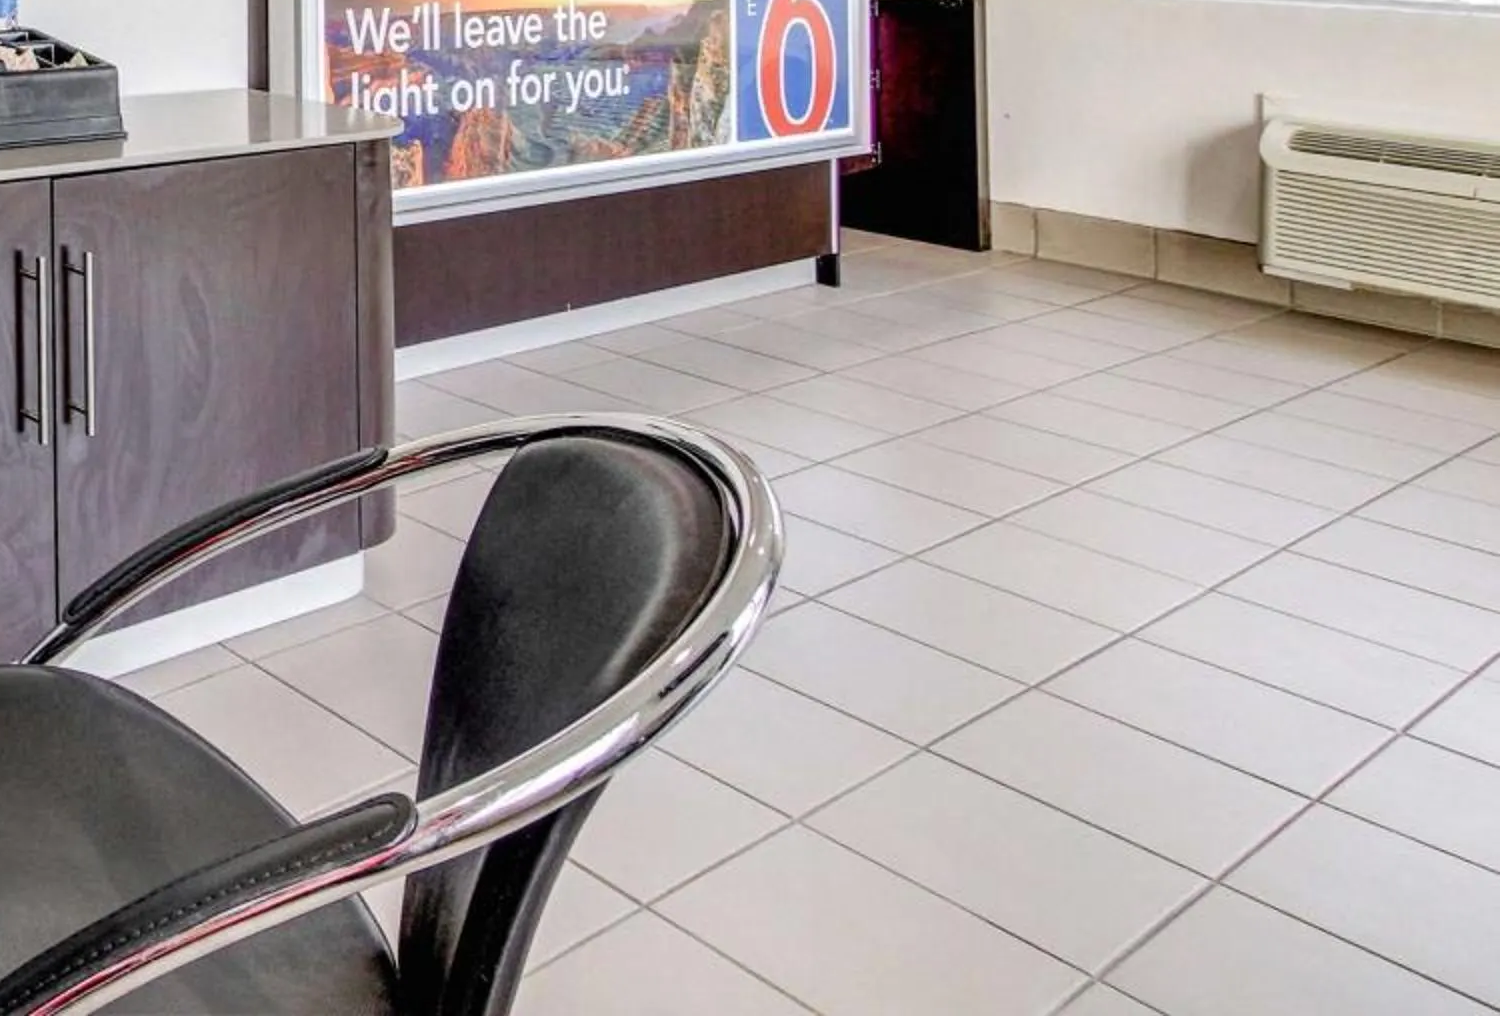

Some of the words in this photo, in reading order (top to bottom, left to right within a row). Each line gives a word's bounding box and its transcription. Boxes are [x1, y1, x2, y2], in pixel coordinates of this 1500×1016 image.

[345, 1, 441, 55] We'll
[453, 0, 543, 49] leave
[450, 75, 497, 113] on
[507, 59, 556, 107] for
